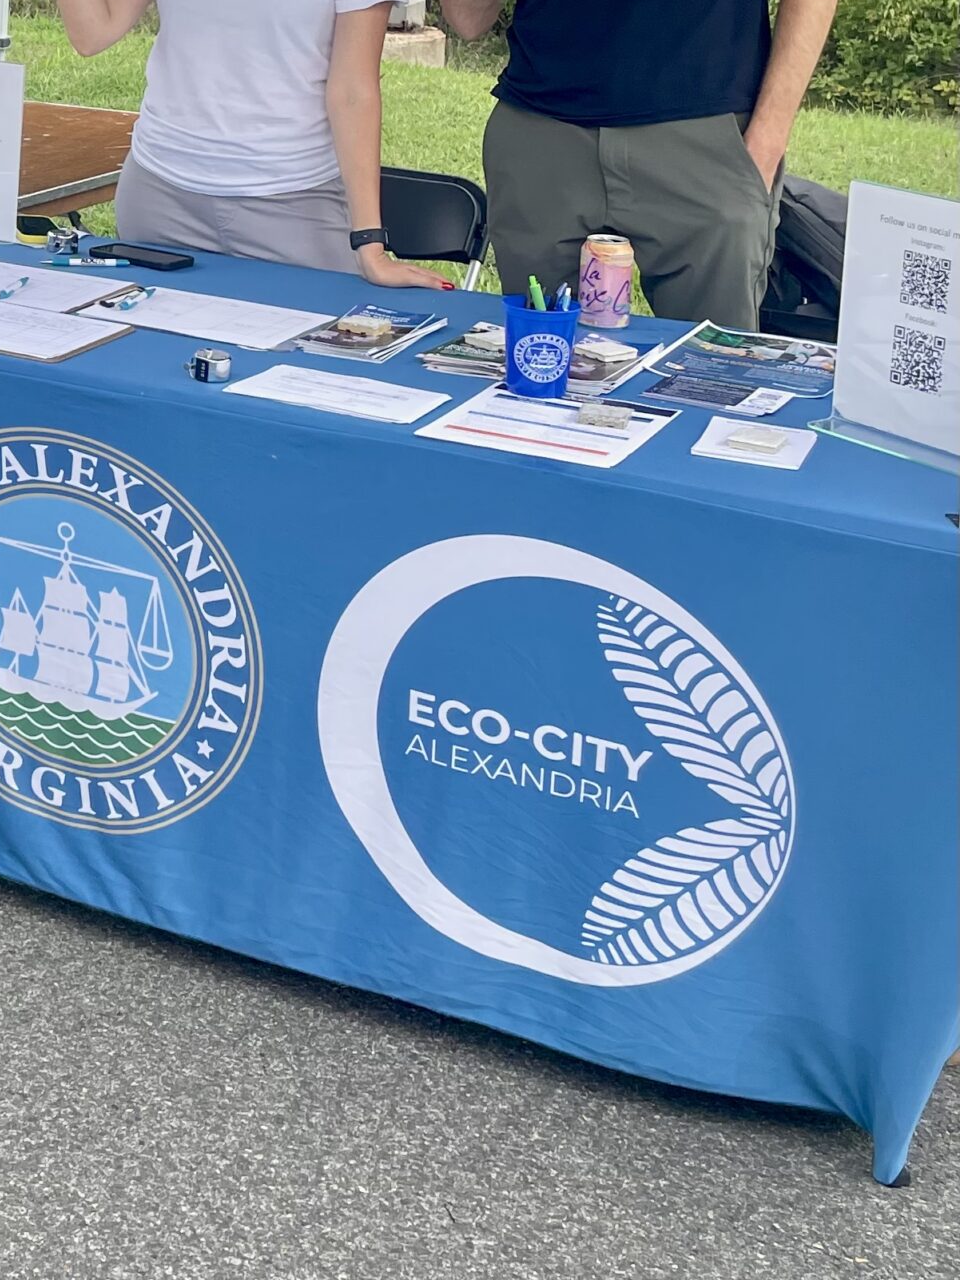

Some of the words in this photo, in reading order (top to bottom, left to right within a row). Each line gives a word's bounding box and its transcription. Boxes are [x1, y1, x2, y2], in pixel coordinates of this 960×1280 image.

[880, 214, 905, 227] Follow
[917, 224, 928, 232] on
[929, 226, 951, 238] social
[405, 734, 640, 819] ALEXANDRIA
[408, 688, 653, 783] ECO-CITY
